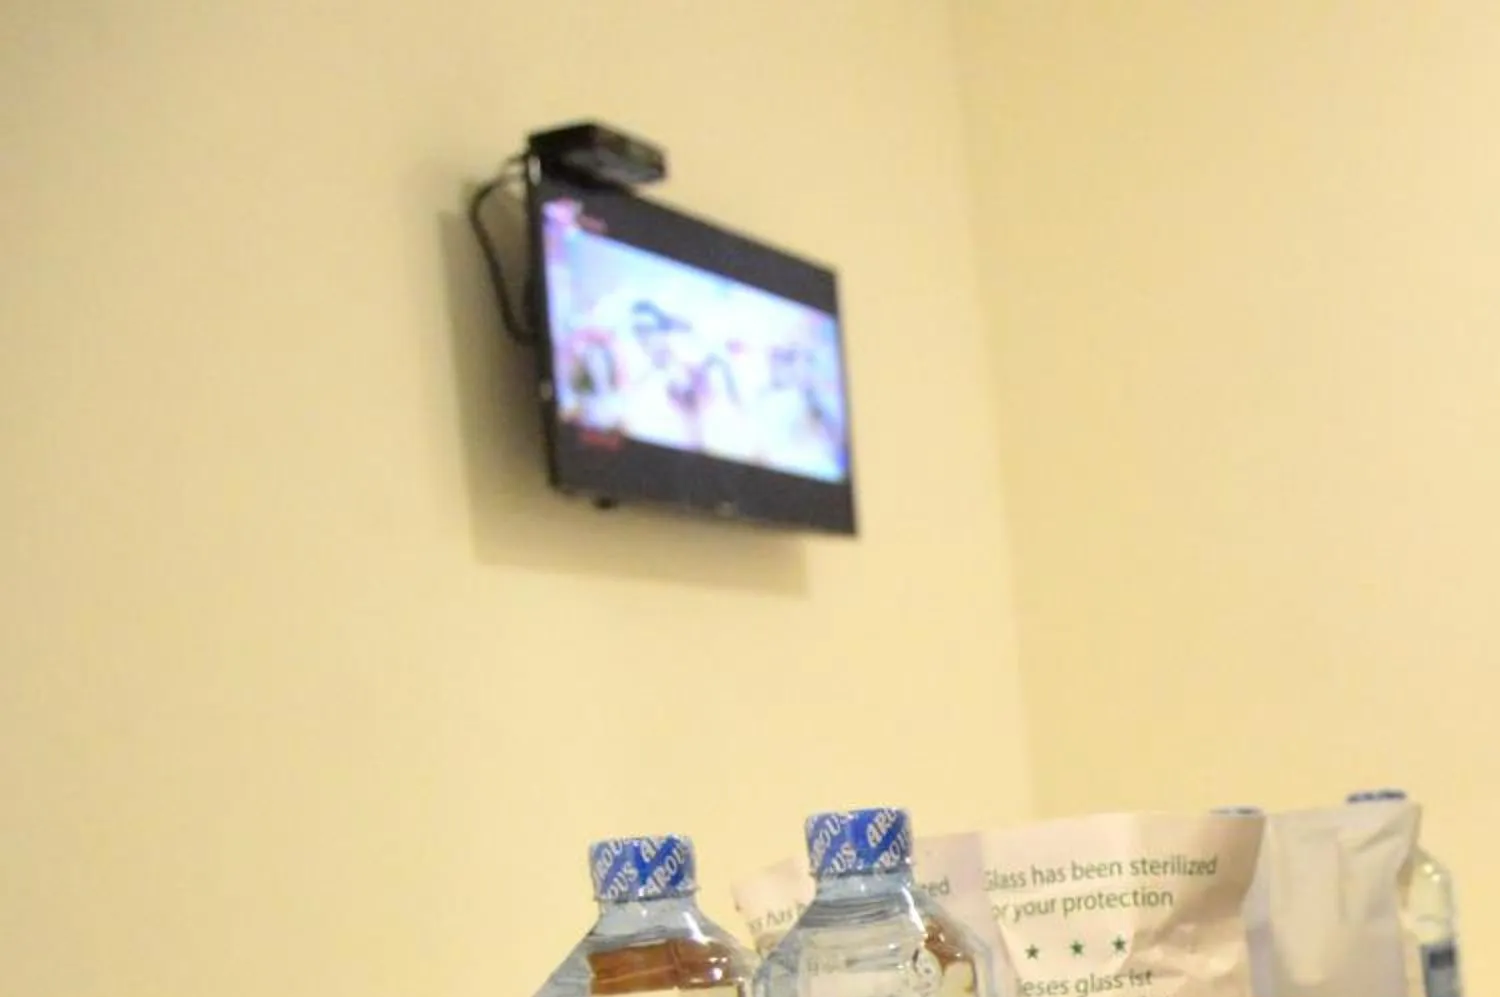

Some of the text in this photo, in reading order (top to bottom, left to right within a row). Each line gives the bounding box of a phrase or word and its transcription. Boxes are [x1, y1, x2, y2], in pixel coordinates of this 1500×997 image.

[1031, 864, 1067, 885] has
[1071, 860, 1123, 881] been
[1129, 855, 1219, 877] sterilized
[1013, 898, 1058, 923] your
[1062, 887, 1174, 918] protection
[1015, 977, 1070, 997] ieses
[1128, 969, 1153, 988] ist
